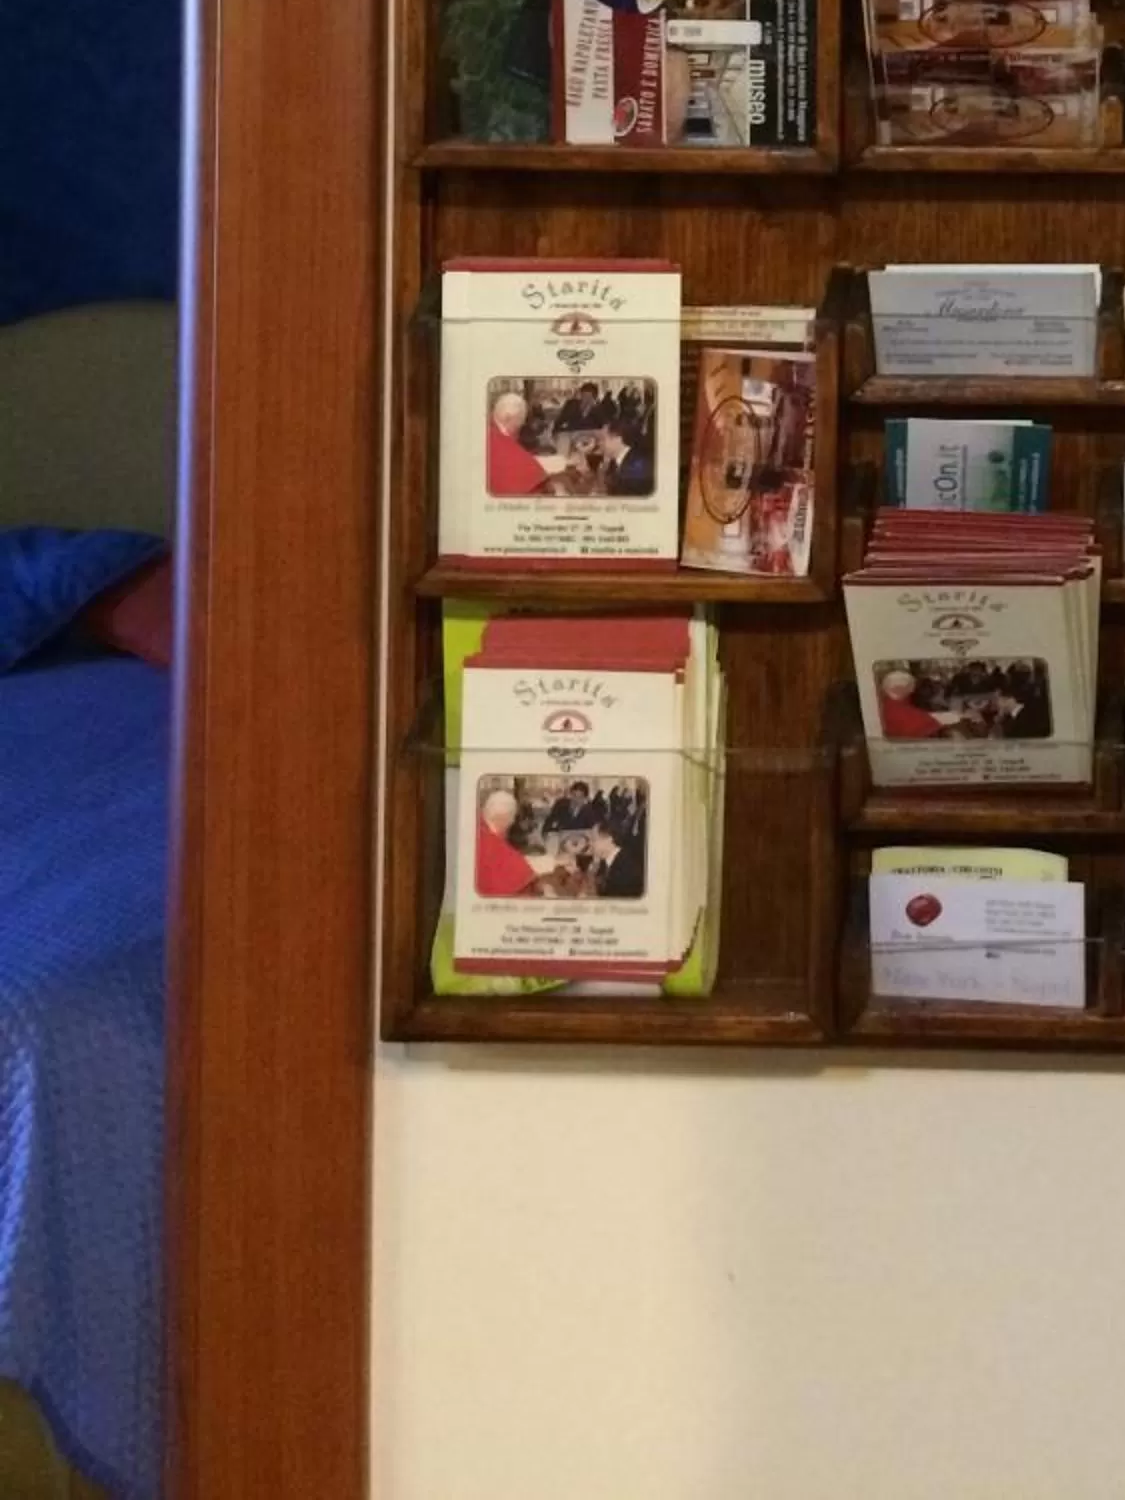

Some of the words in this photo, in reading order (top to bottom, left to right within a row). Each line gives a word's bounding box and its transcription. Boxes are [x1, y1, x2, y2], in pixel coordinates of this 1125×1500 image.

[749, 59, 767, 125] museo
[521, 279, 627, 311] Starita
[896, 591, 1008, 613] Starita
[512, 677, 618, 708] Starita
